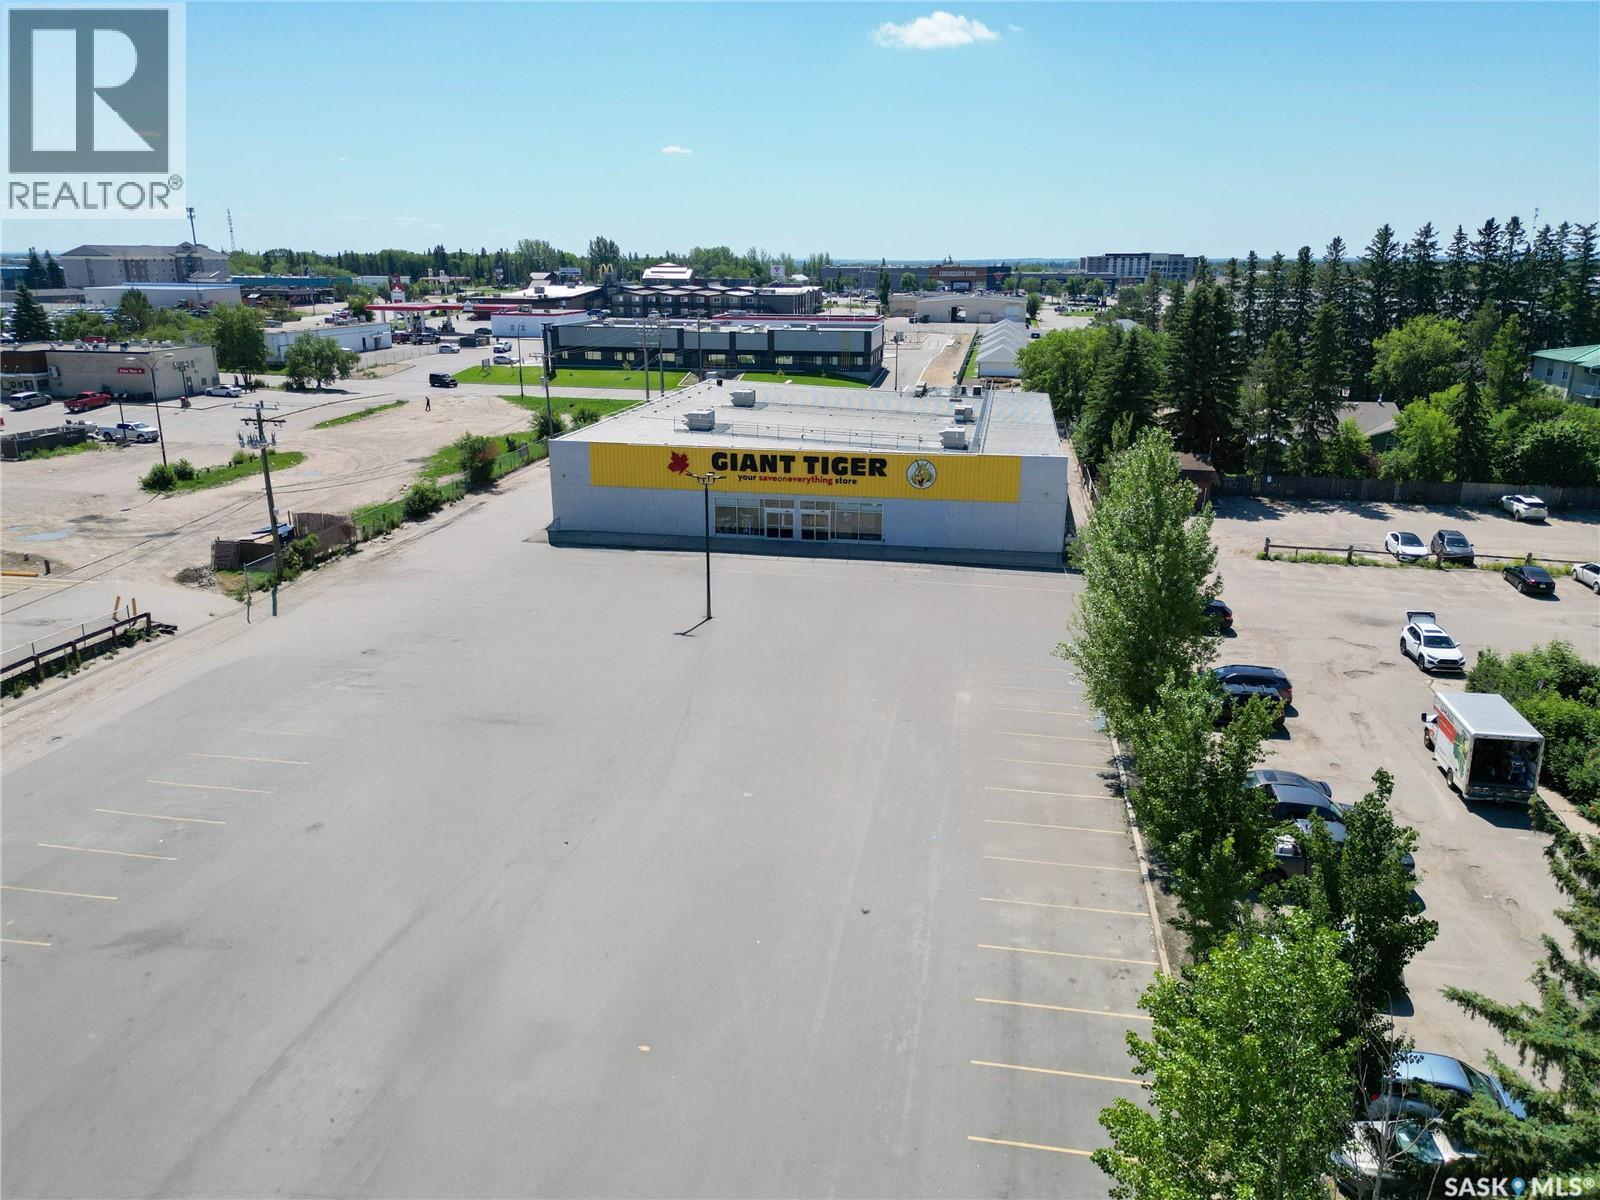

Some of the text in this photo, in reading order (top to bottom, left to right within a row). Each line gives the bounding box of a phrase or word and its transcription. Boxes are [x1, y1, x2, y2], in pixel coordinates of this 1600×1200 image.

[711, 451, 888, 477] GIANT TIGER
[737, 473, 858, 486] your saveoneverything store
